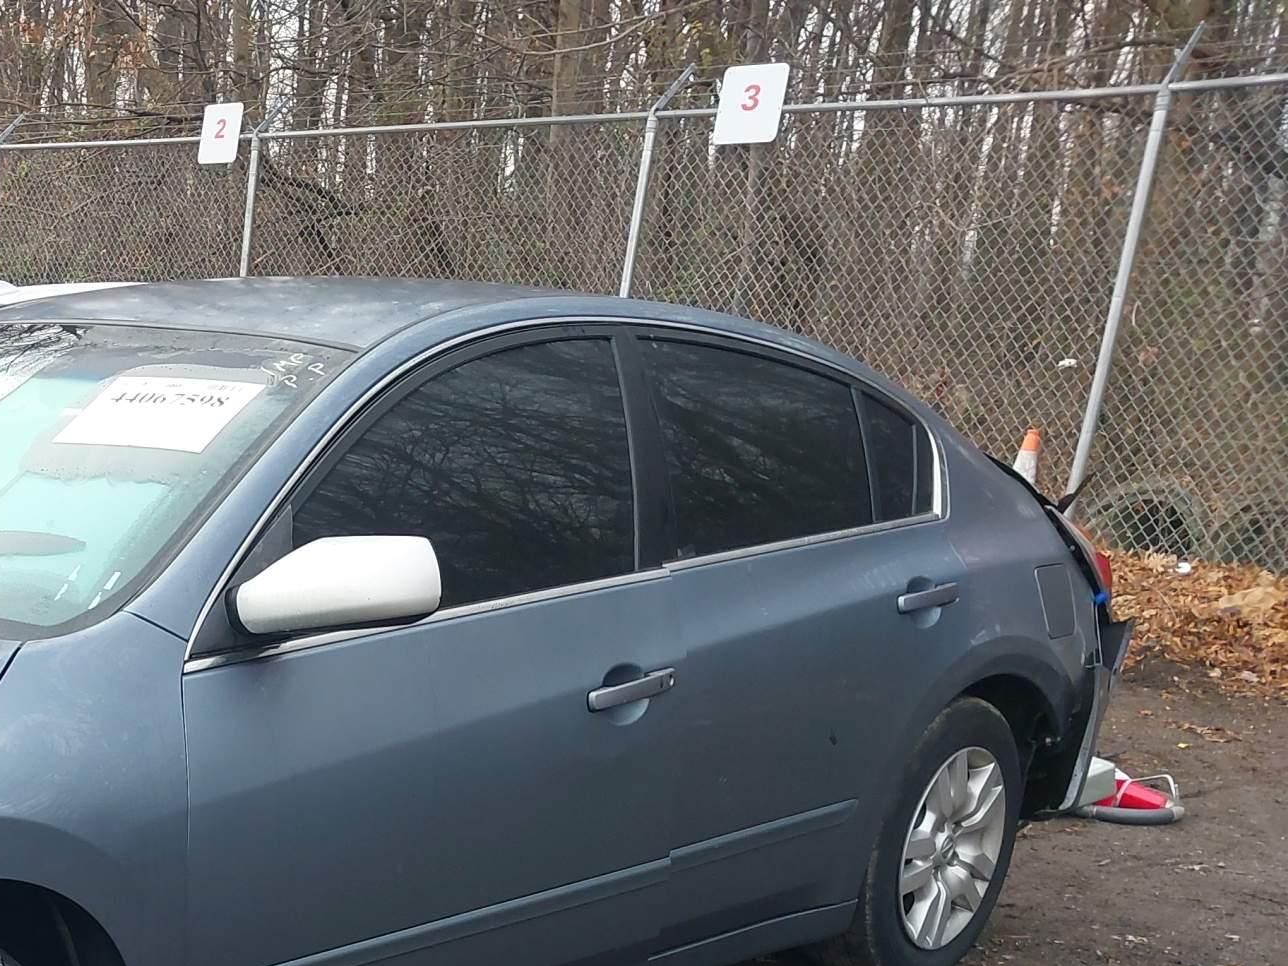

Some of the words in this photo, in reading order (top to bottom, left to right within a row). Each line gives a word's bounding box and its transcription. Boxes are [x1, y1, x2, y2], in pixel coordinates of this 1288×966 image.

[741, 84, 761, 112] 3
[214, 118, 227, 139] 2
[111, 391, 231, 408] 44067598
